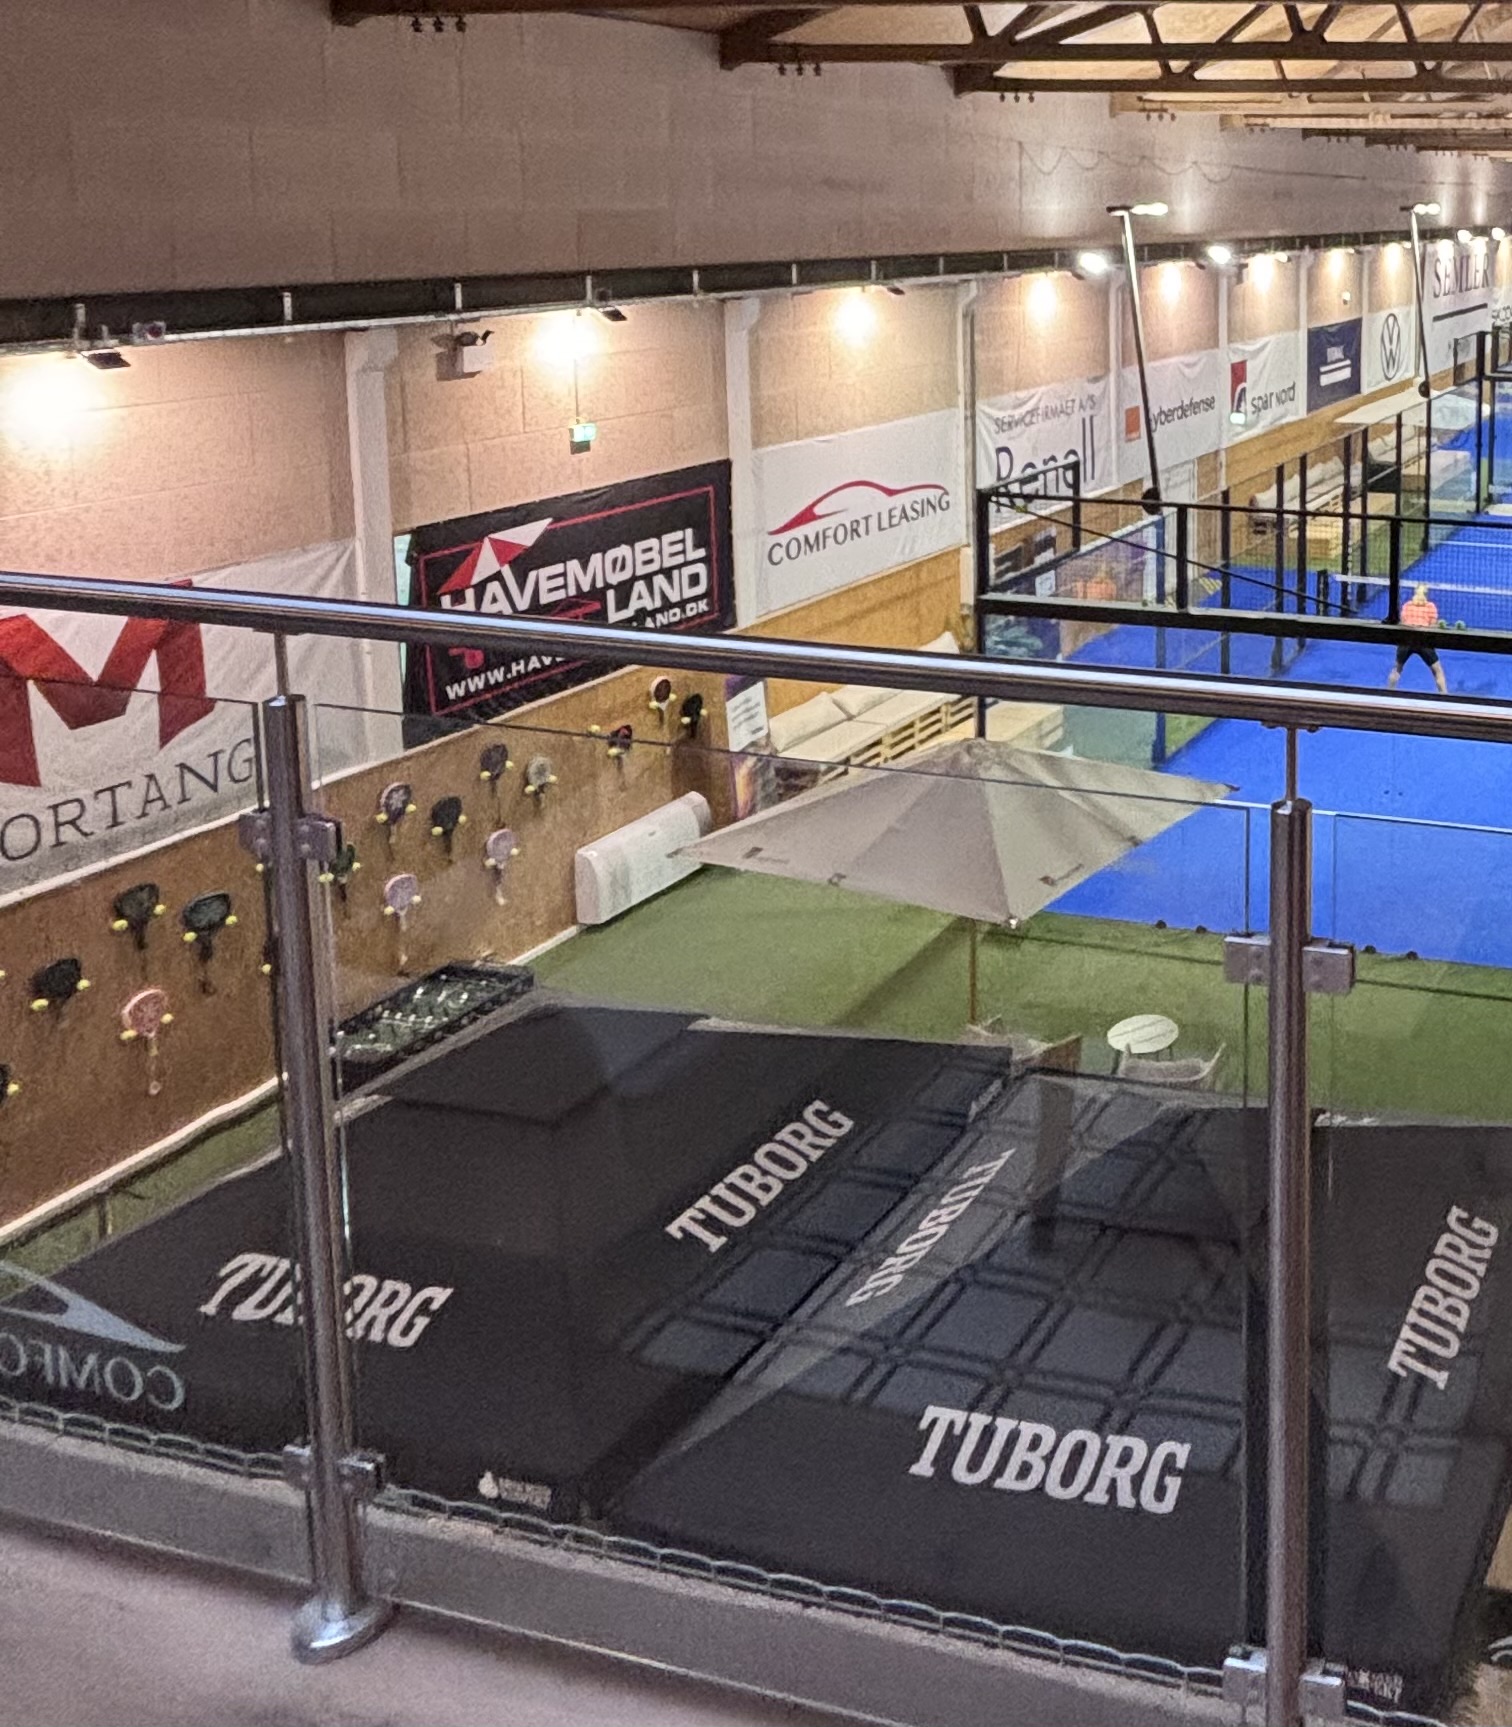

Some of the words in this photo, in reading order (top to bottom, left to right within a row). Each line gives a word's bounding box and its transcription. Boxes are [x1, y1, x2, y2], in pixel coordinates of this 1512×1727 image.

[1433, 252, 1491, 299] SEMLER
[1149, 394, 1216, 433] yberdefense
[440, 527, 706, 616] HAVEMØBEL
[767, 516, 873, 567] COMFORT
[876, 489, 951, 533] LEASING
[606, 562, 709, 625] LAND
[665, 1098, 855, 1254] TUBORG
[844, 1147, 1018, 1309] TUBORG
[1387, 1204, 1500, 1391] TUBORG
[907, 1404, 1193, 1516] TUBORG
